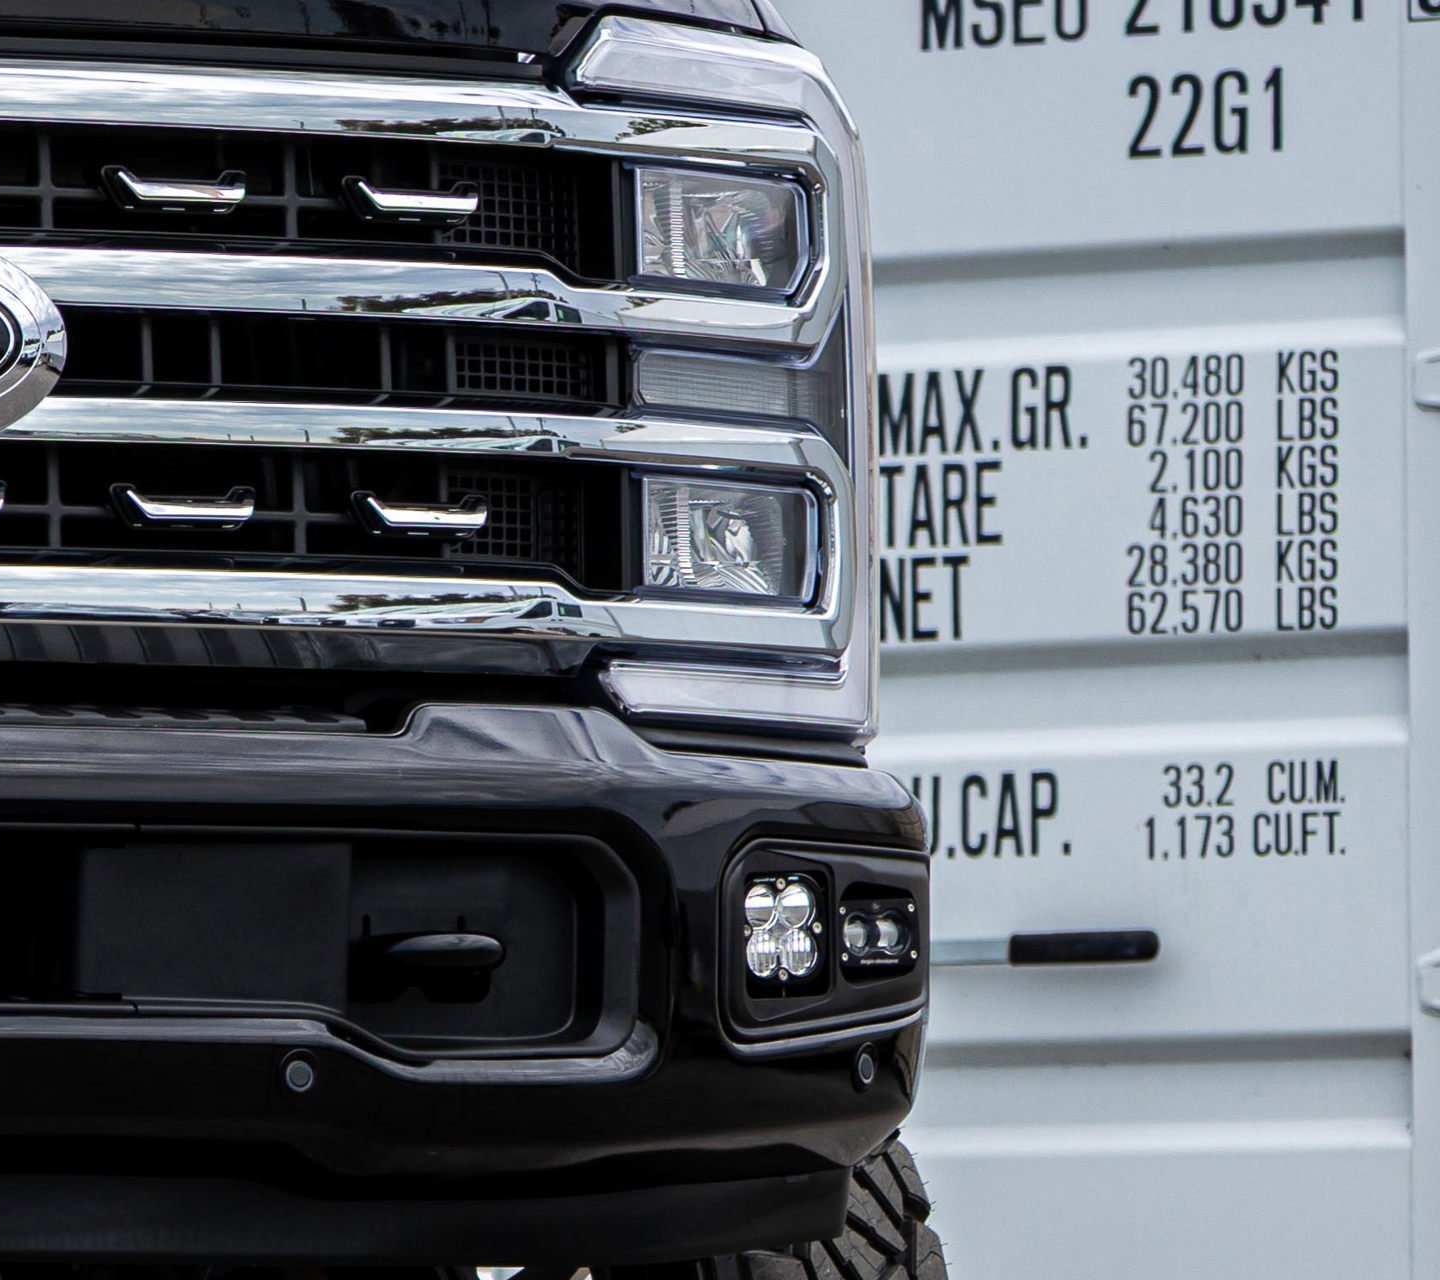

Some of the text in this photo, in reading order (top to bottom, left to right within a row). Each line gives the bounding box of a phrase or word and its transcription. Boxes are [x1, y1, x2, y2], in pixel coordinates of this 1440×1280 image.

[1128, 66, 1284, 160] 22G1
[1277, 349, 1339, 394] KGS
[1277, 397, 1339, 442] LBS
[879, 461, 1003, 549] TARE
[1277, 445, 1339, 489] KGS
[1277, 492, 1339, 536] LBS
[879, 555, 970, 643] NET
[1277, 539, 1339, 584] KGS
[1277, 585, 1339, 631] LBS
[1163, 763, 1235, 808] 33.2
[1267, 758, 1346, 805] CU.M.
[1252, 810, 1347, 857] CU.FT.
